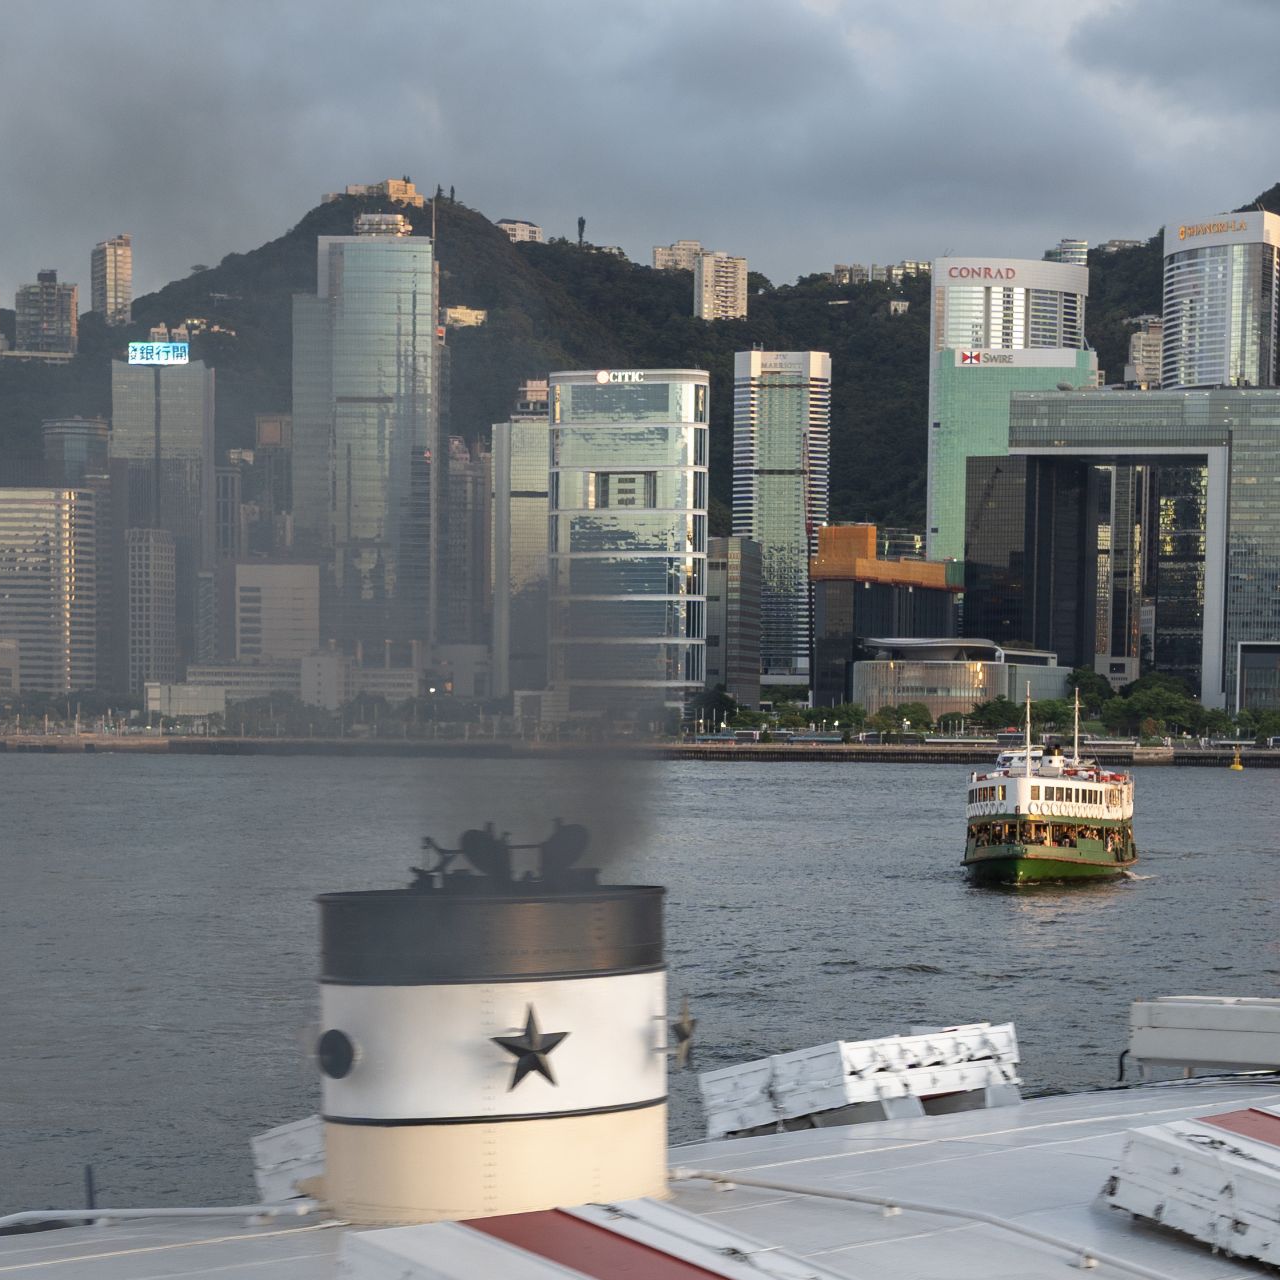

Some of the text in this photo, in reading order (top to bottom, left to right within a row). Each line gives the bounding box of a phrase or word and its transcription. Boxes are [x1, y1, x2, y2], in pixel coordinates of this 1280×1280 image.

[1186, 219, 1248, 238] SHANGRI-LA
[948, 266, 1016, 280] CONRAD
[609, 371, 644, 383] CITIC
